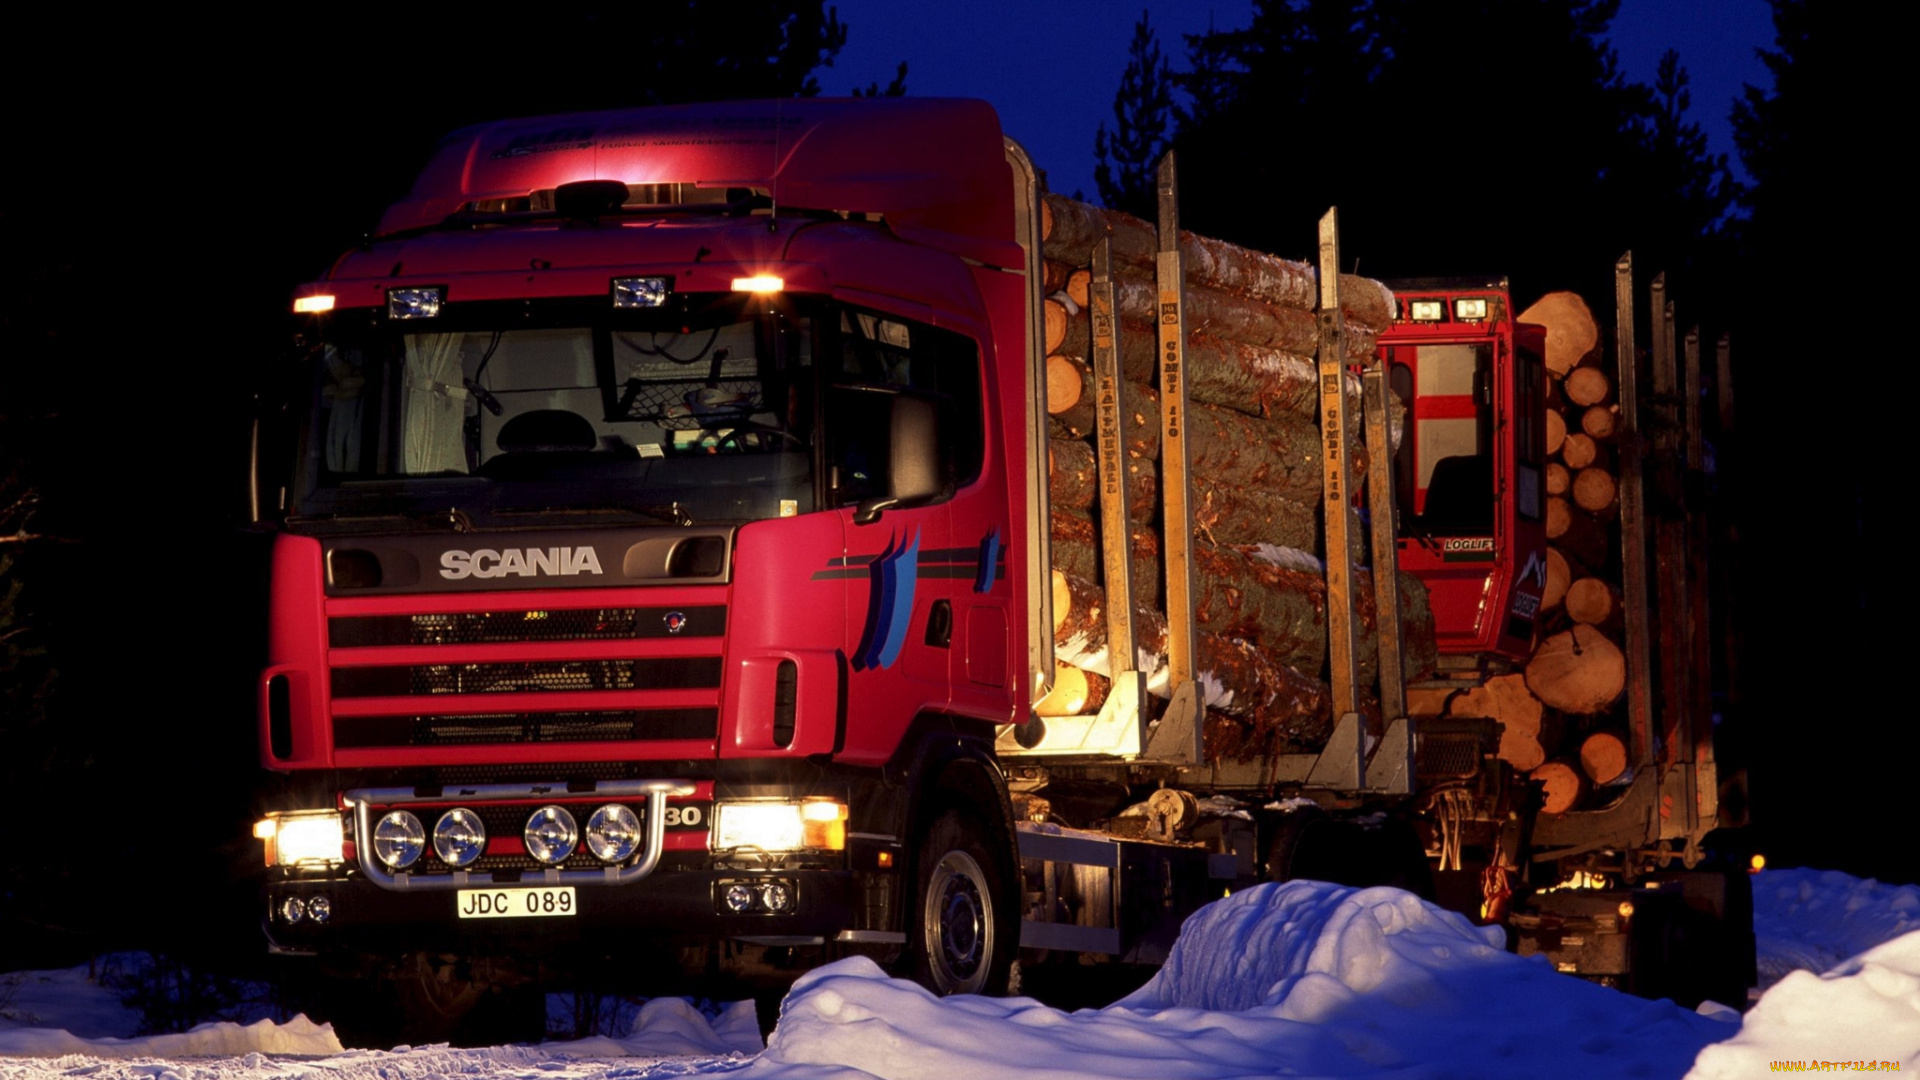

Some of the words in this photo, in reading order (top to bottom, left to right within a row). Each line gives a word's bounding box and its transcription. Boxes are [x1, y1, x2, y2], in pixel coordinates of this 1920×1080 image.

[1164, 341, 1178, 393] COMBI
[1168, 405, 1179, 438] 110
[1326, 410, 1339, 459] COMBI
[1330, 470, 1341, 501] 110
[439, 545, 603, 580] SCANIA
[462, 892, 509, 915] JDC
[525, 888, 573, 912] 089
